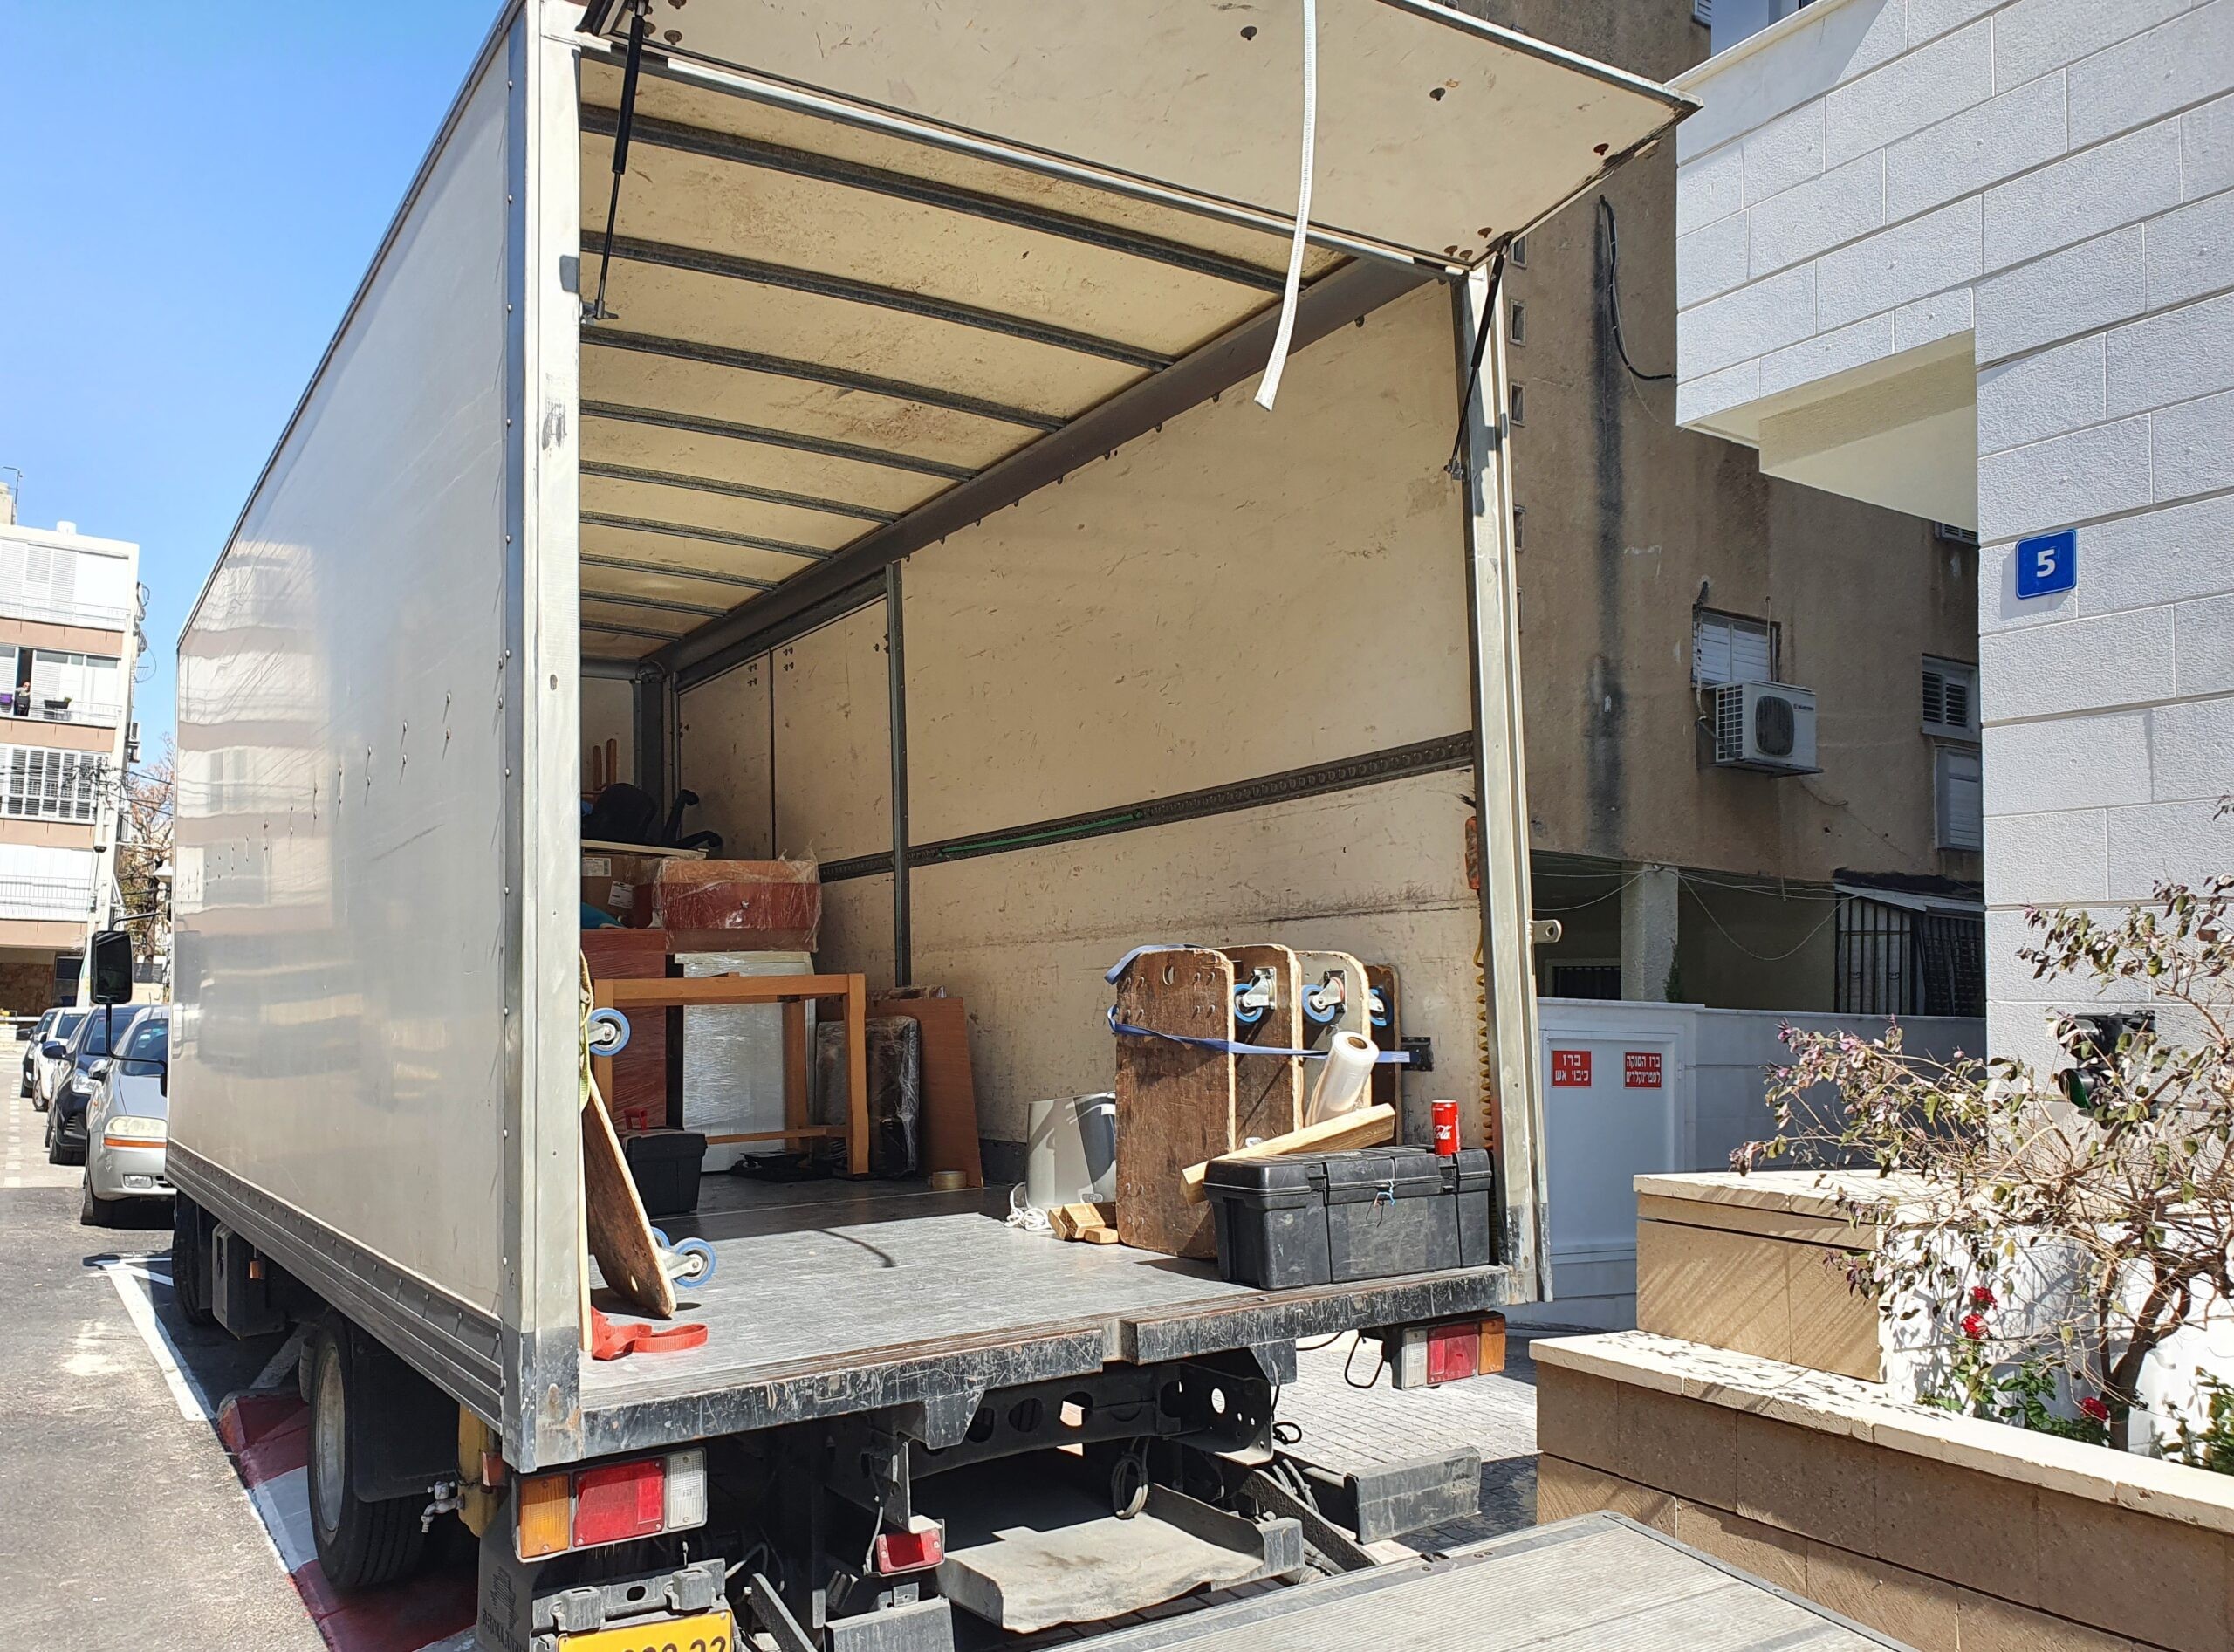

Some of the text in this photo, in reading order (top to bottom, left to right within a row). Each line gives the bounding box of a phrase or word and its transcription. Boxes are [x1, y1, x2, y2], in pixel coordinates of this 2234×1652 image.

[2036, 548, 2056, 578] 5
[1563, 1054, 1581, 1066] ברז
[1555, 1070, 1589, 1081] כיבוי אש
